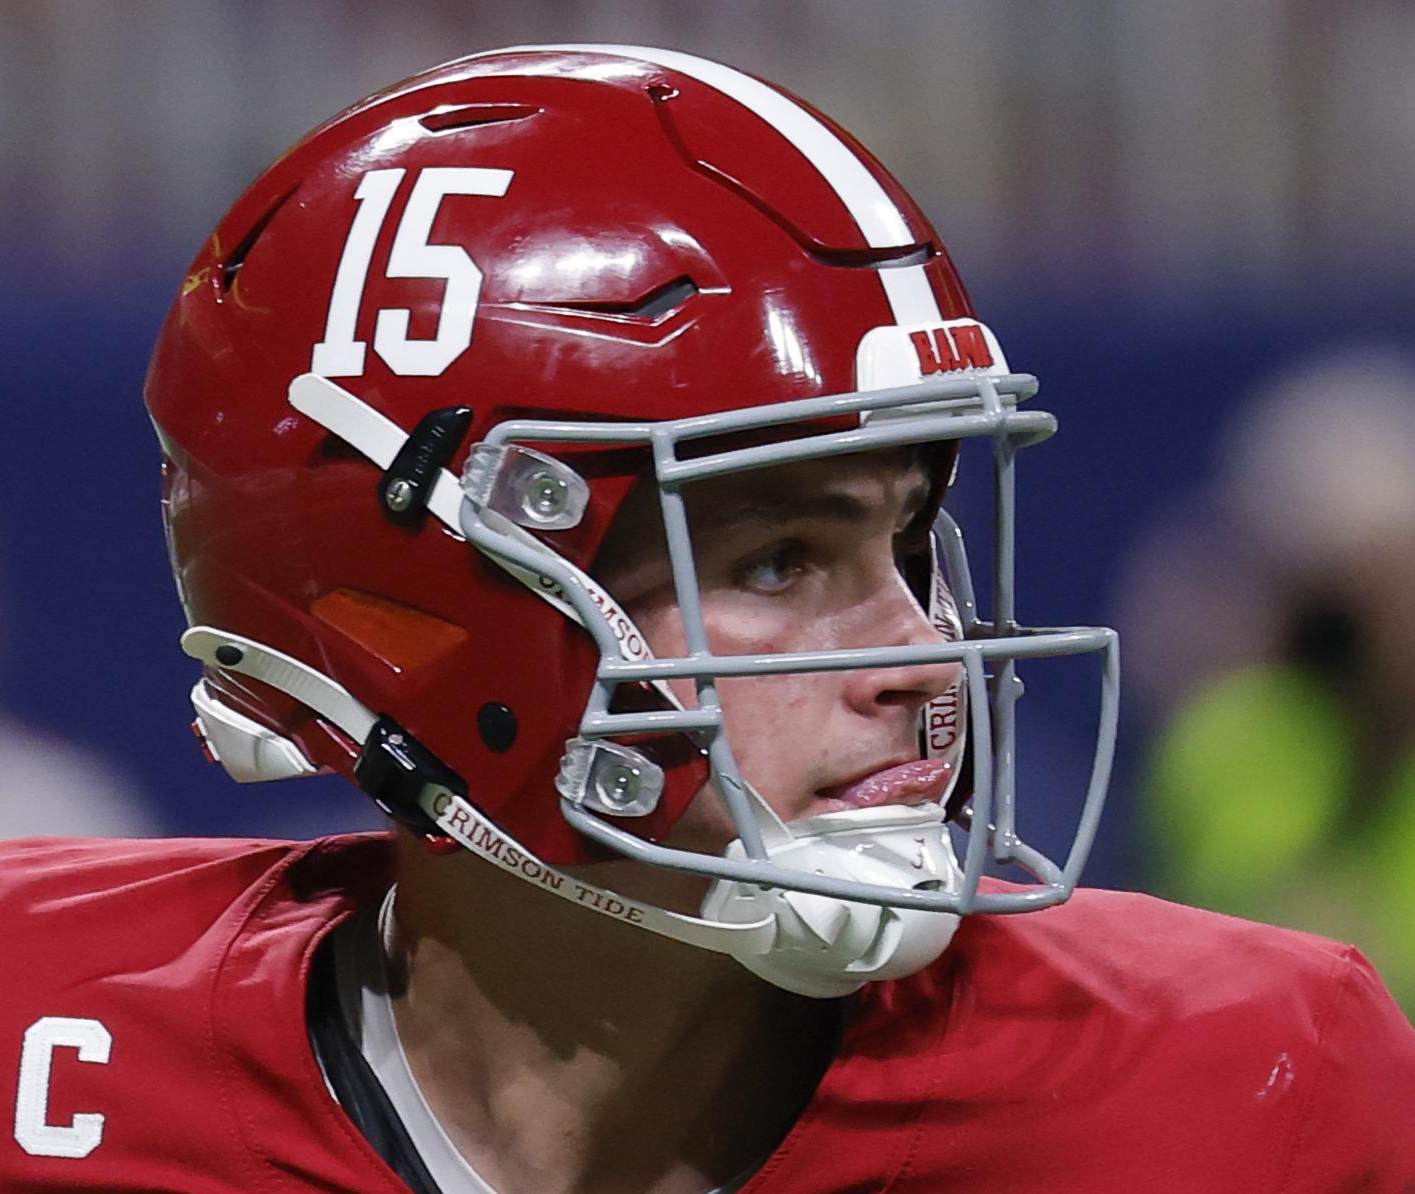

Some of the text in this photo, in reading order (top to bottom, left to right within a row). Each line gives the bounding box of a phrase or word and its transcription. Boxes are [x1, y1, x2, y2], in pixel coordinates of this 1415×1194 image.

[311, 167, 515, 377] 15
[432, 793, 645, 924] CRIMSON TIDE
[14, 1016, 112, 1158] C
